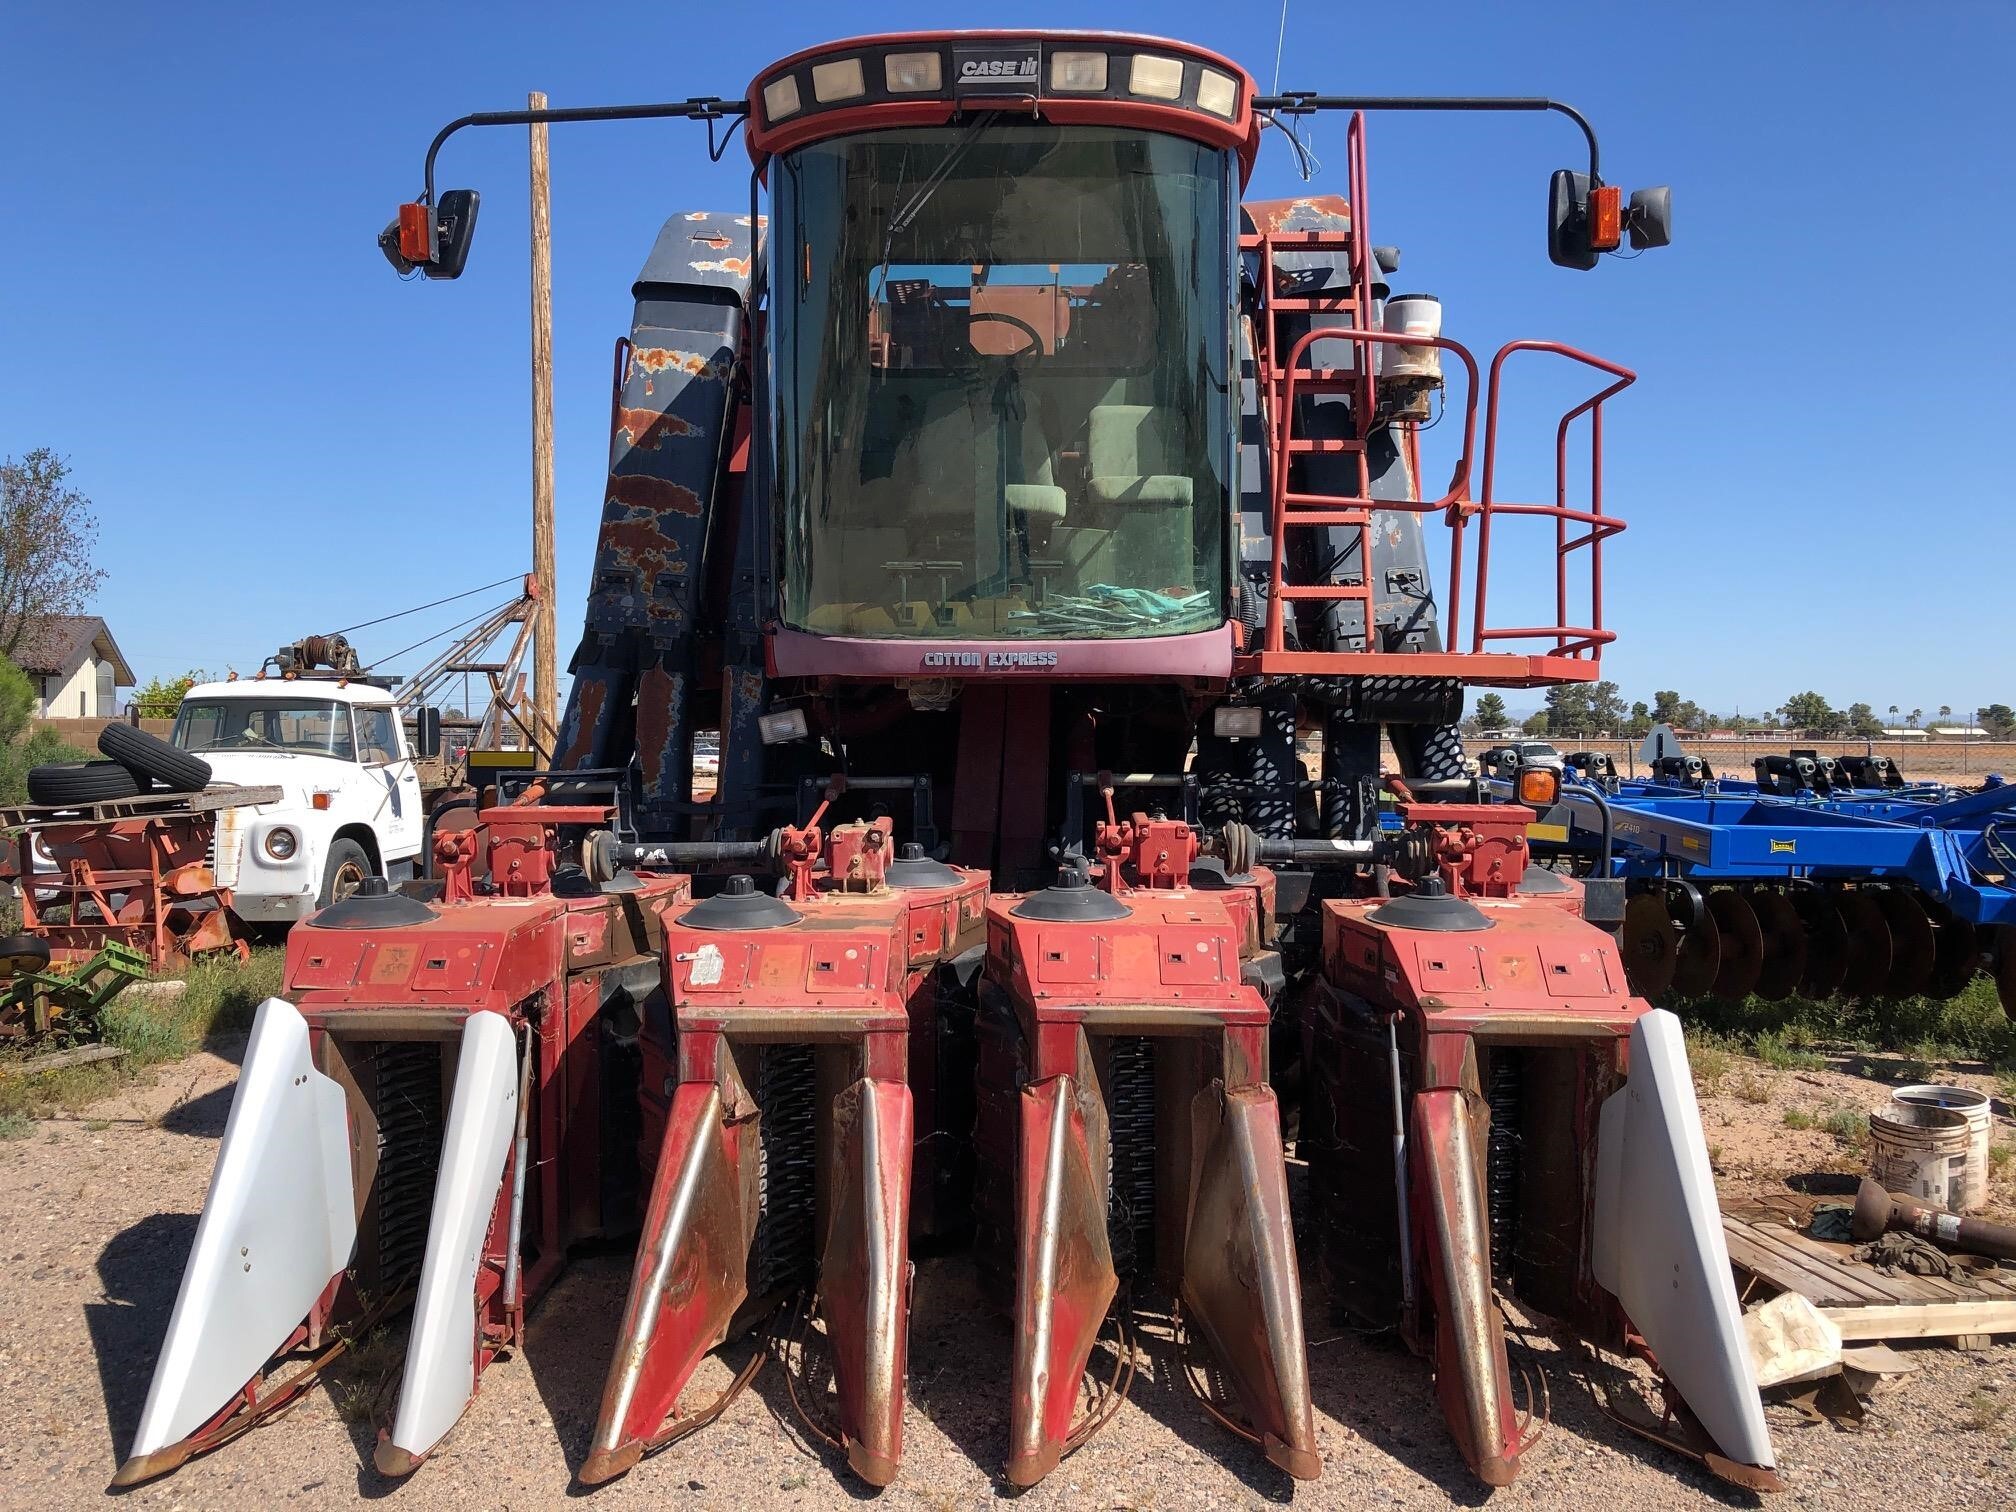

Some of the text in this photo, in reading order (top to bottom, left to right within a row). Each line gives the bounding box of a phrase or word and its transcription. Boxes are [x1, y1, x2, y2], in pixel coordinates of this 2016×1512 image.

[961, 61, 1017, 76] CASE
[924, 651, 1058, 666] COTTON EXPRESS
